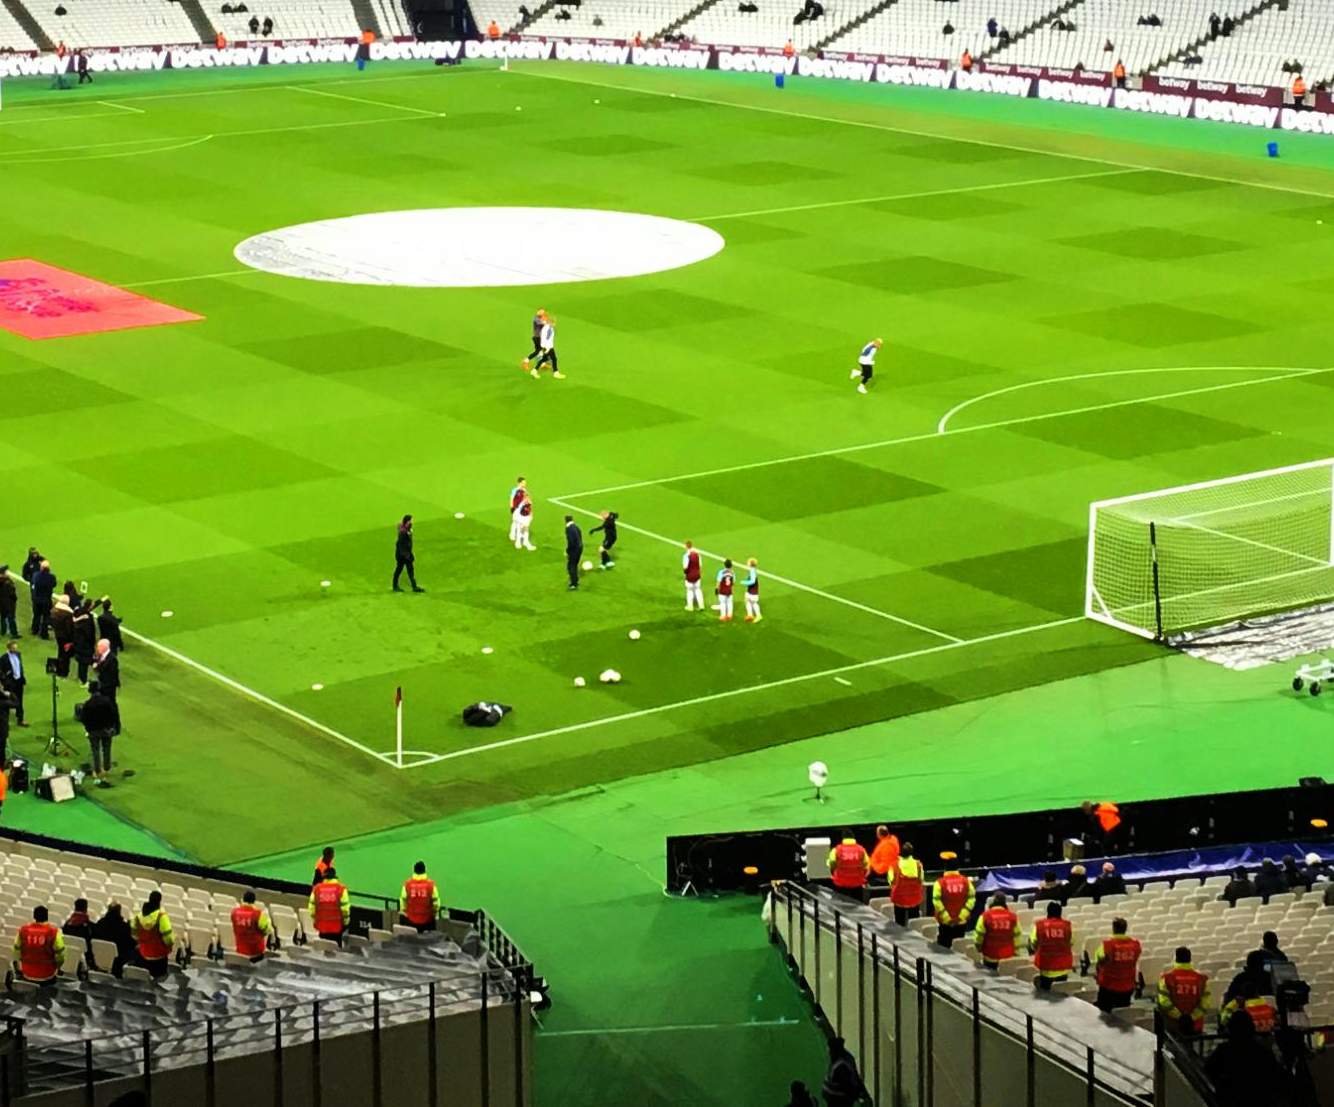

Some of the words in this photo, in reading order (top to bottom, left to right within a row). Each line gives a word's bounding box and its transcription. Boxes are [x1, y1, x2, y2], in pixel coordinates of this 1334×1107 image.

[1159, 77, 1190, 91] betway
[1197, 80, 1228, 94] betway
[1235, 84, 1267, 98] betway
